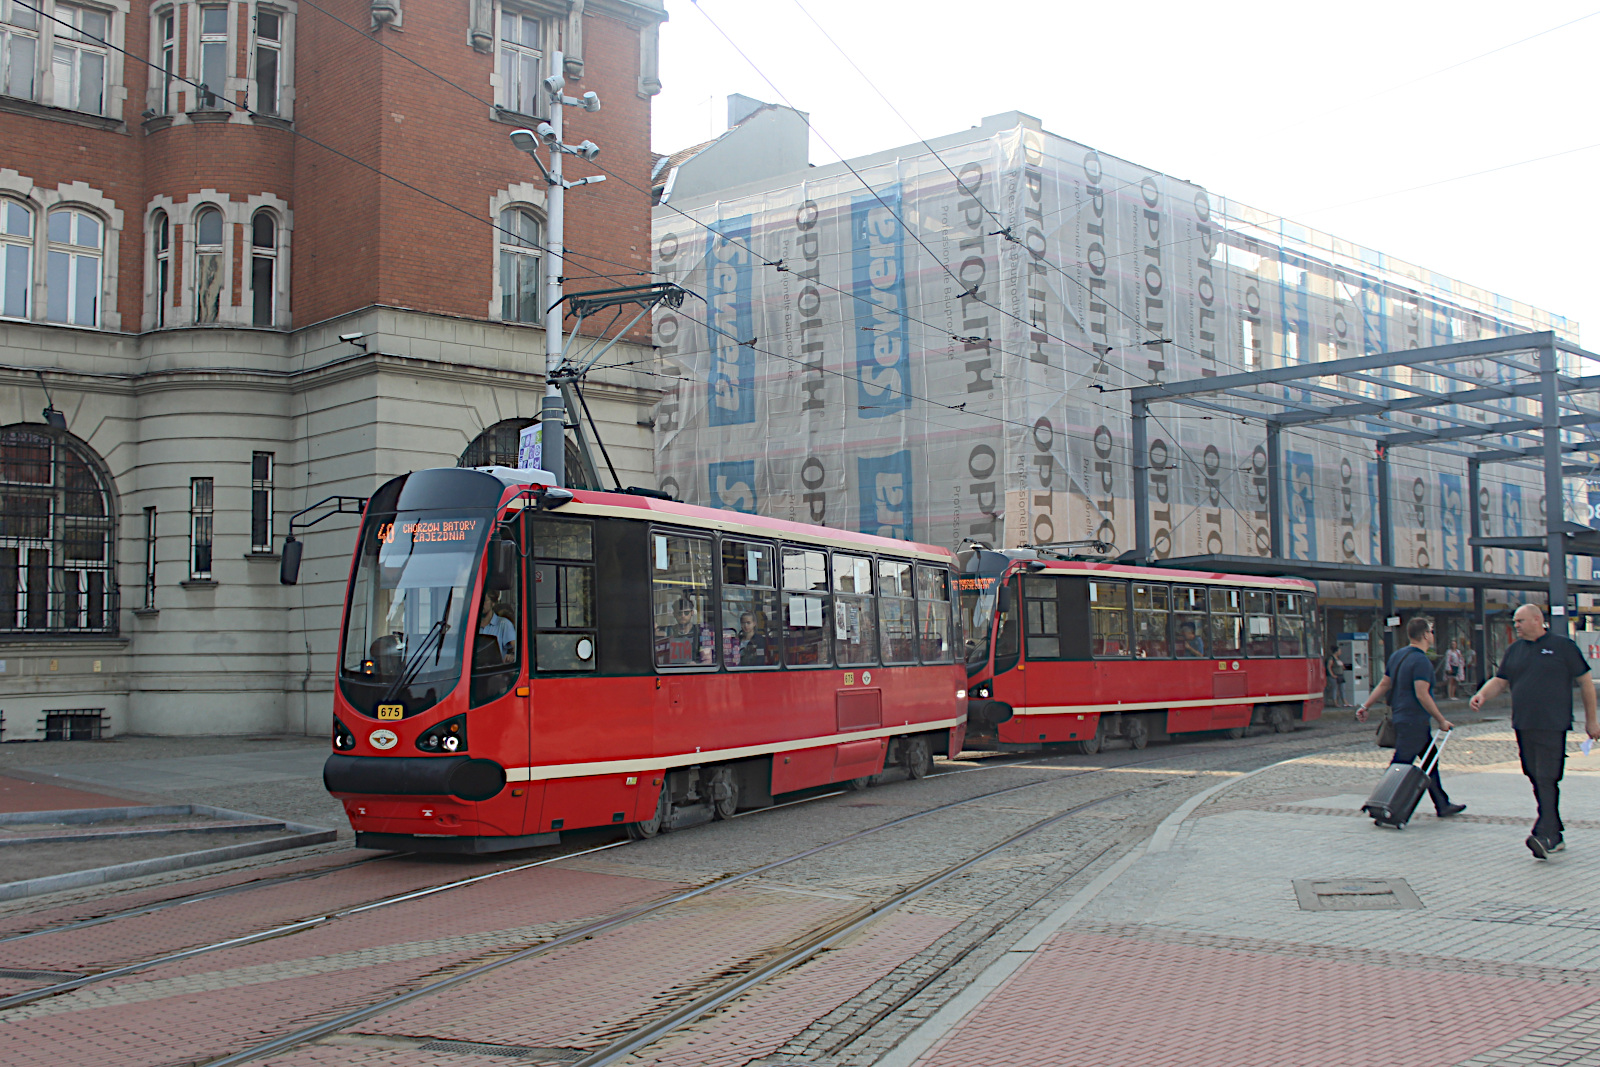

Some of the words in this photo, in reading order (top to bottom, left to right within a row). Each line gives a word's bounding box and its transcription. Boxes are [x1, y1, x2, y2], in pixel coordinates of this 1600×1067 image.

[658, 232, 682, 432] OPOLITH
[712, 236, 749, 412] Sewera
[783, 239, 793, 312] Profesionelle
[796, 199, 826, 409] OPTOLITH
[860, 205, 902, 400] Sewera
[956, 161, 994, 394] OPTOLITH
[1023, 131, 1049, 365] OPTOLITH
[1083, 150, 1109, 376] OPTOLITH
[377, 523, 395, 543] 40
[413, 531, 466, 542] ZAJEZDNIA
[442, 520, 477, 532] BATORY
[381, 707, 400, 717] 675
